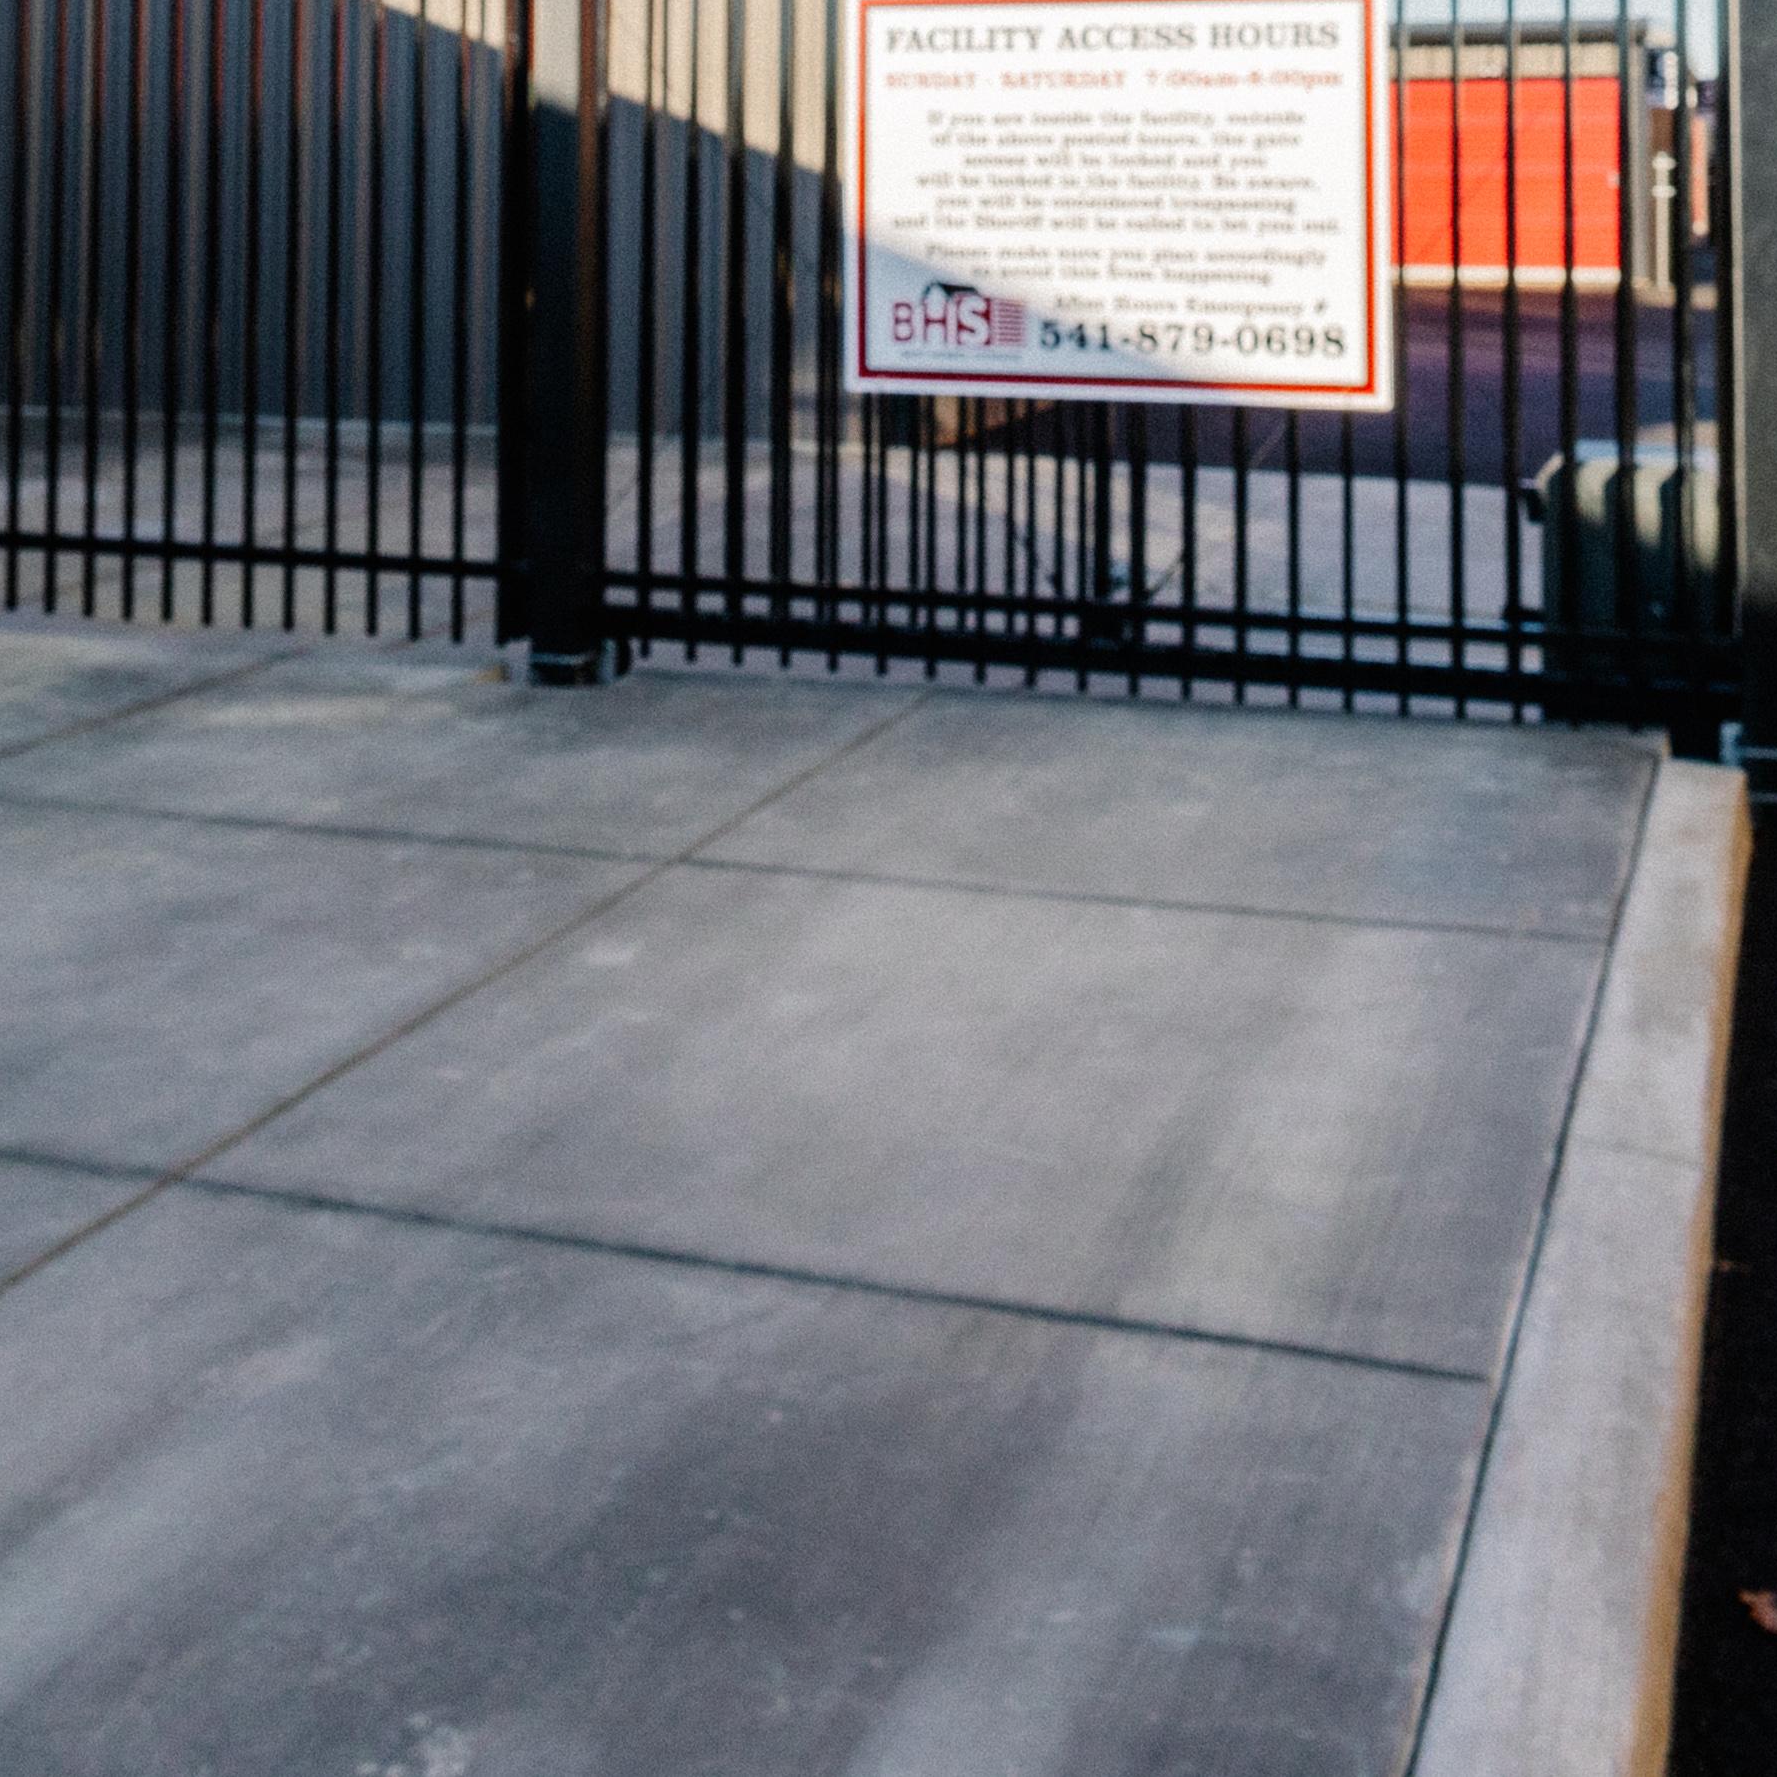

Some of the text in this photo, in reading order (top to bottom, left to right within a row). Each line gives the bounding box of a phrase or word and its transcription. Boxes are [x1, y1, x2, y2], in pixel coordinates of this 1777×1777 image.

[886, 21, 1339, 53] FACILITY ACCESS HOURS
[885, 72, 975, 89] SUNDAY
[1000, 70, 1126, 89] SATURDAY
[893, 286, 991, 346] BHS
[1040, 320, 1344, 357] 541-879-0698
